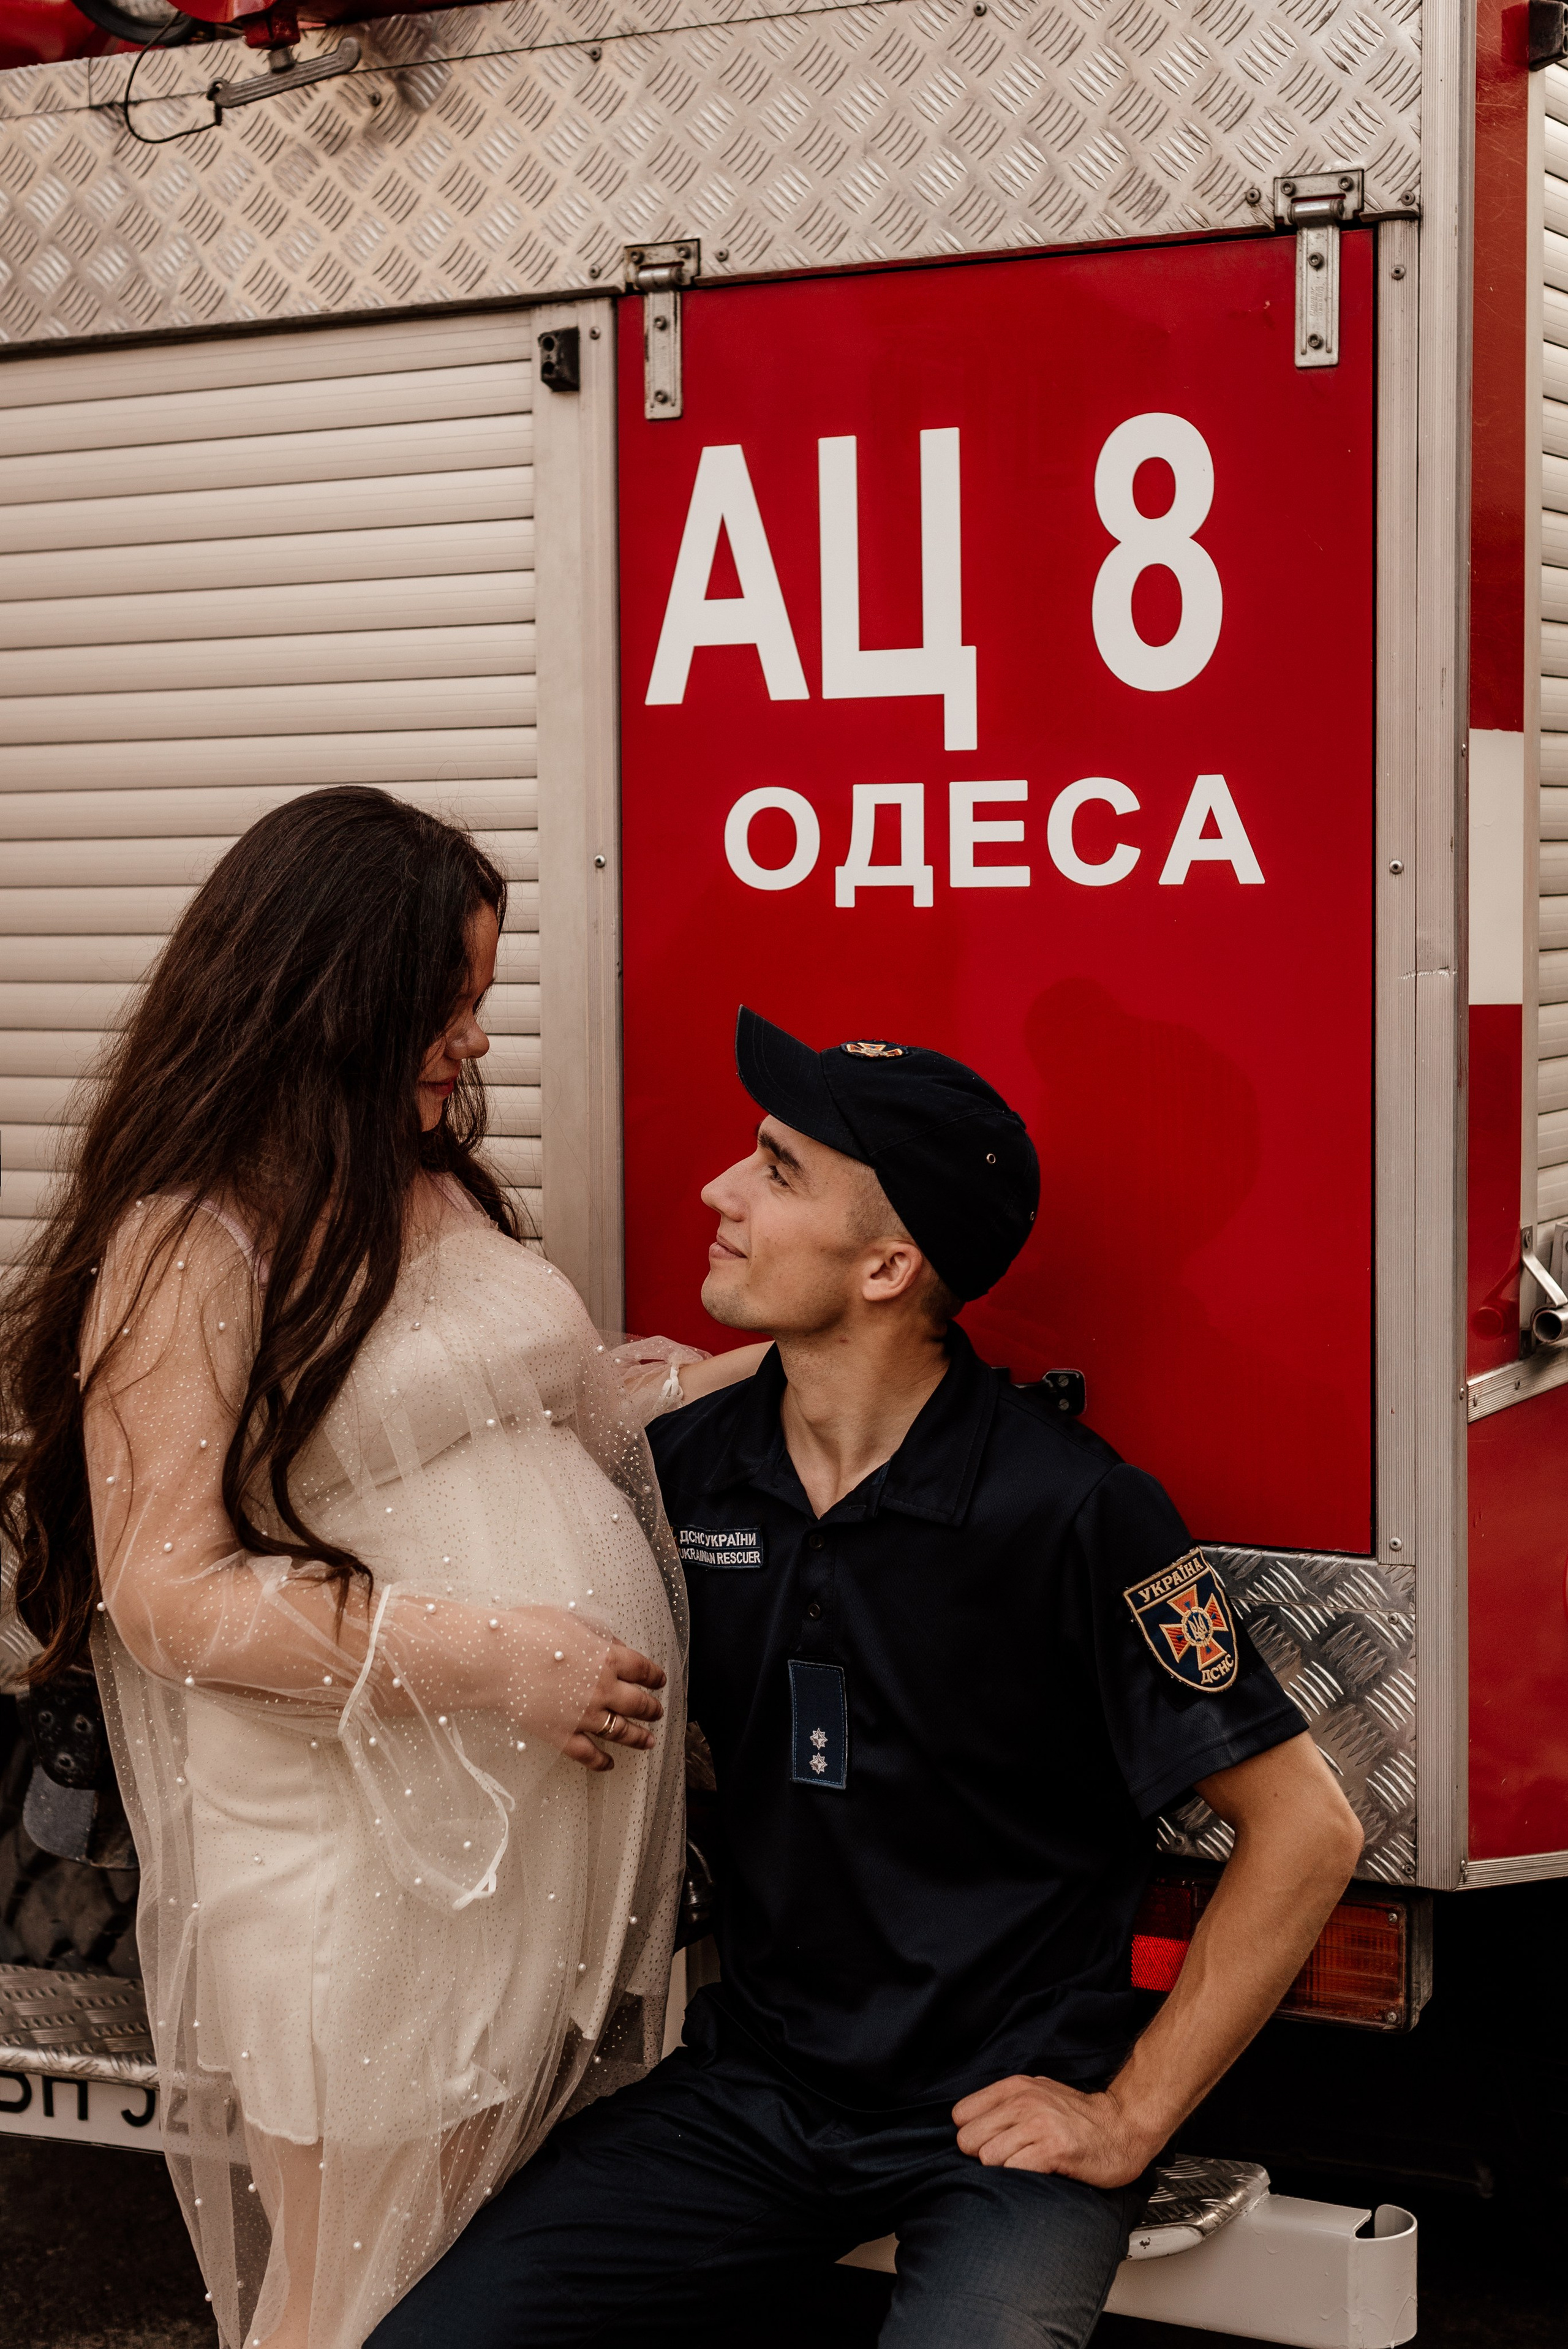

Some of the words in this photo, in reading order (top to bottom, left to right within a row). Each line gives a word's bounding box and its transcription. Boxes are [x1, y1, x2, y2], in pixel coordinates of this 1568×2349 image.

[645, 427, 978, 751] АЦ
[1091, 412, 1223, 692] 8
[724, 774, 1265, 908] ОДЕСА
[716, 1551, 761, 1565] RESCUER
[1138, 1558, 1204, 1603] УКРАЇНА
[1201, 1654, 1234, 1684] ДСНС
